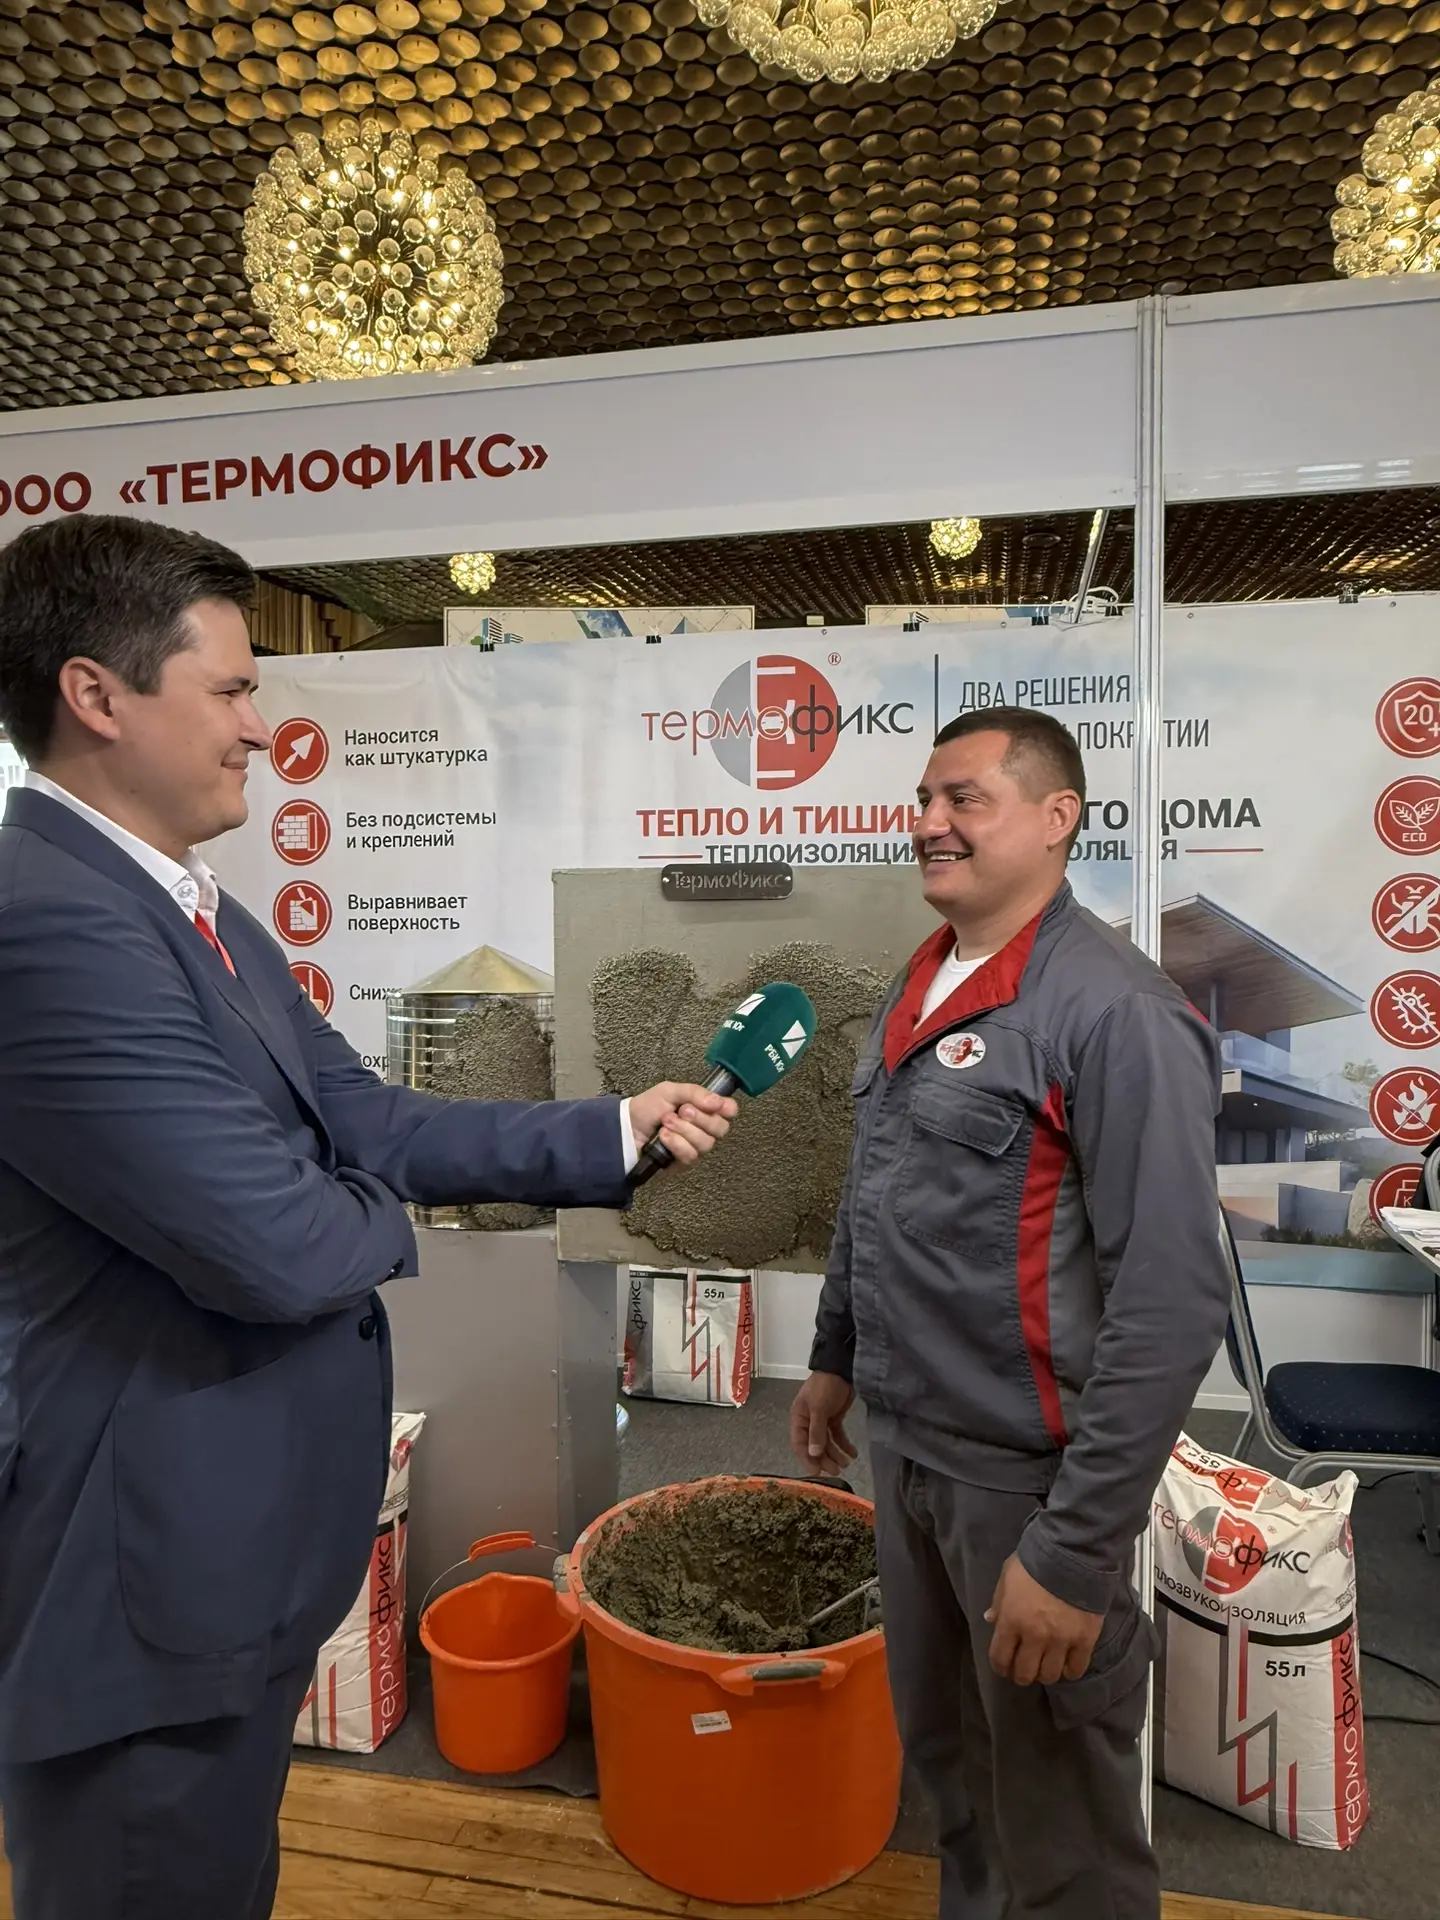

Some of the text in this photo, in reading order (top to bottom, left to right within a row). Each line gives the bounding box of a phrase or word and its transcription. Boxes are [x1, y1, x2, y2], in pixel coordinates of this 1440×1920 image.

[119, 433, 549, 505] «ТЕРМОФИКС»
[959, 674, 1131, 713] ДВА РЕШЕНИЯ
[641, 684, 915, 756] термофикс
[344, 729, 439, 745] Наносится
[345, 749, 488, 768] как штукатурка
[346, 811, 497, 830] Без подсистемы
[636, 807, 749, 837] ТЕПЛО
[759, 806, 783, 835] И
[346, 829, 455, 852] и креплений
[1402, 832, 1427, 843] ECO
[347, 894, 468, 913] Выравнивает
[347, 917, 461, 934] поверхность
